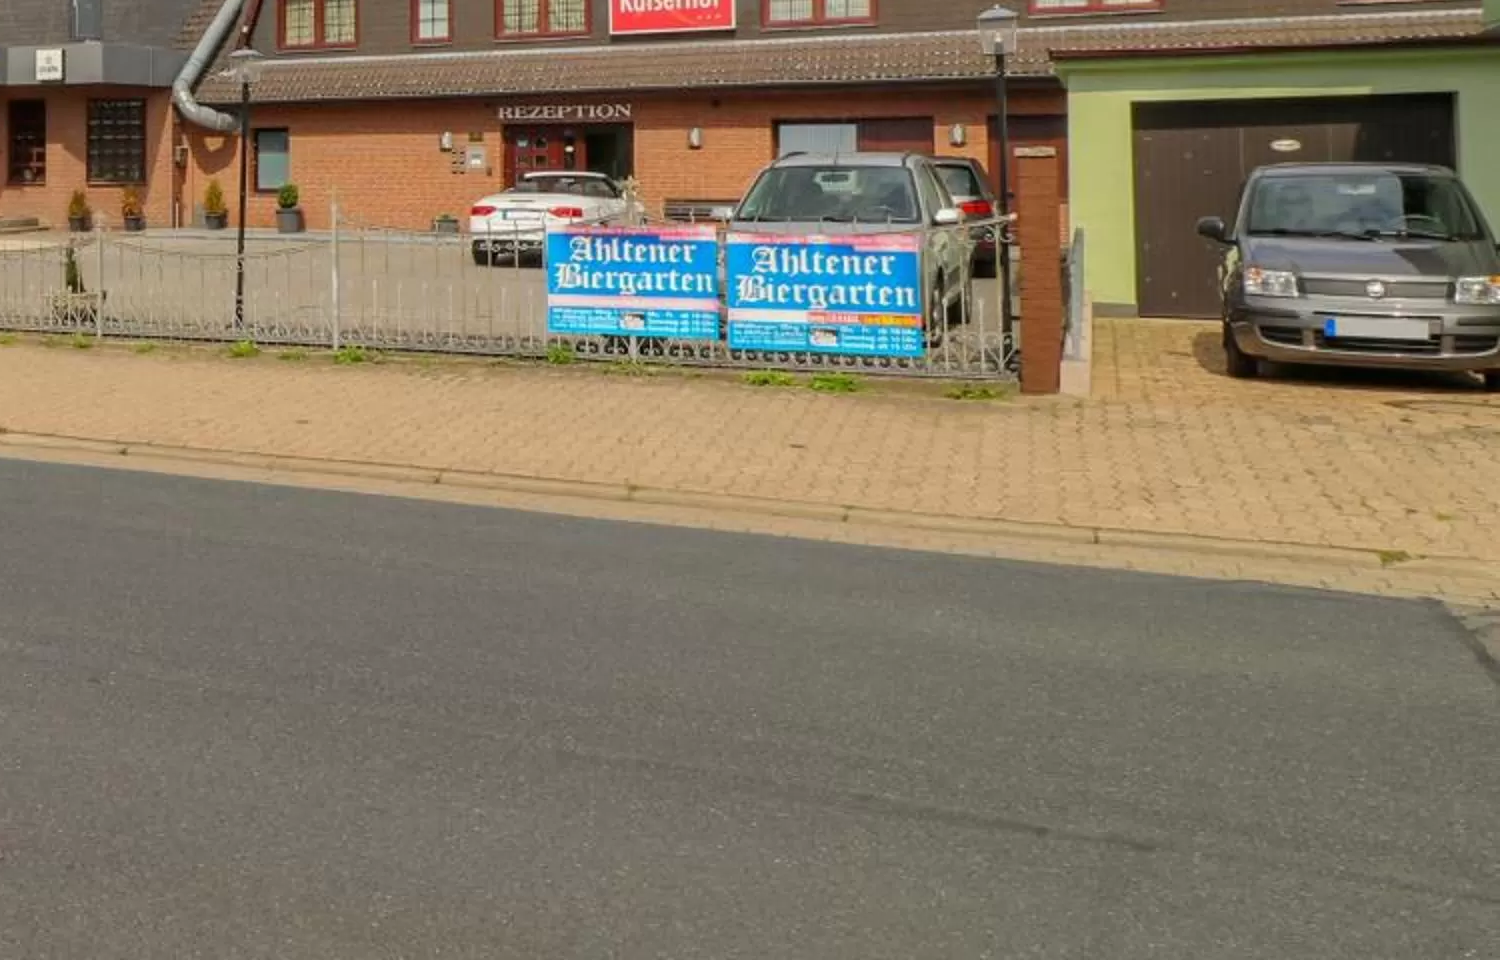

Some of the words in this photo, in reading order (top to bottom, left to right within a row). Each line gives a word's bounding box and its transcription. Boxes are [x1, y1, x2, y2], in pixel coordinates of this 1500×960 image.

[499, 103, 632, 119] REZEPTION
[569, 235, 698, 265] Ahltener
[751, 245, 897, 277] Ahltener
[554, 262, 714, 296] Biergarten
[735, 274, 916, 309] Biergarten
